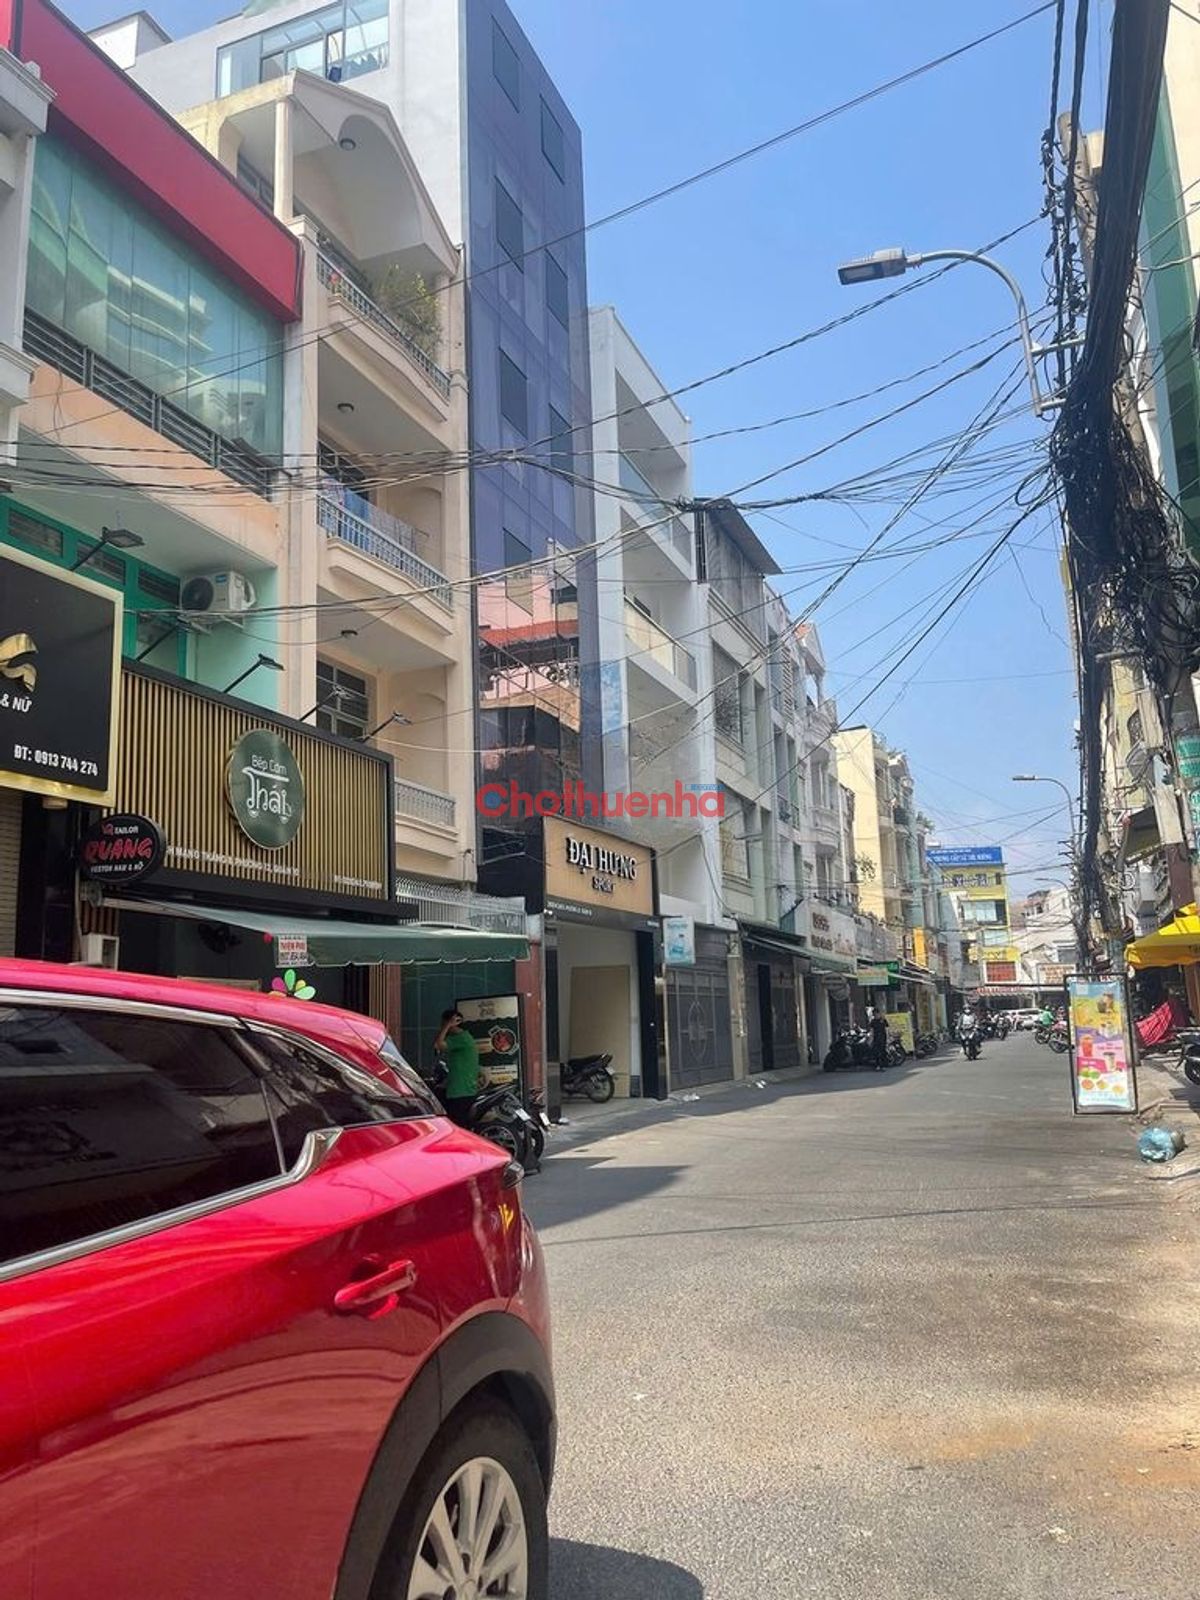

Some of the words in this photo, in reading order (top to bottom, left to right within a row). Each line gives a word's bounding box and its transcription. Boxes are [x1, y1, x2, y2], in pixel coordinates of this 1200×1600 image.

[34, 749, 60, 767] 0913
[60, 754, 79, 772] 744
[251, 754, 268, 772] Bếp
